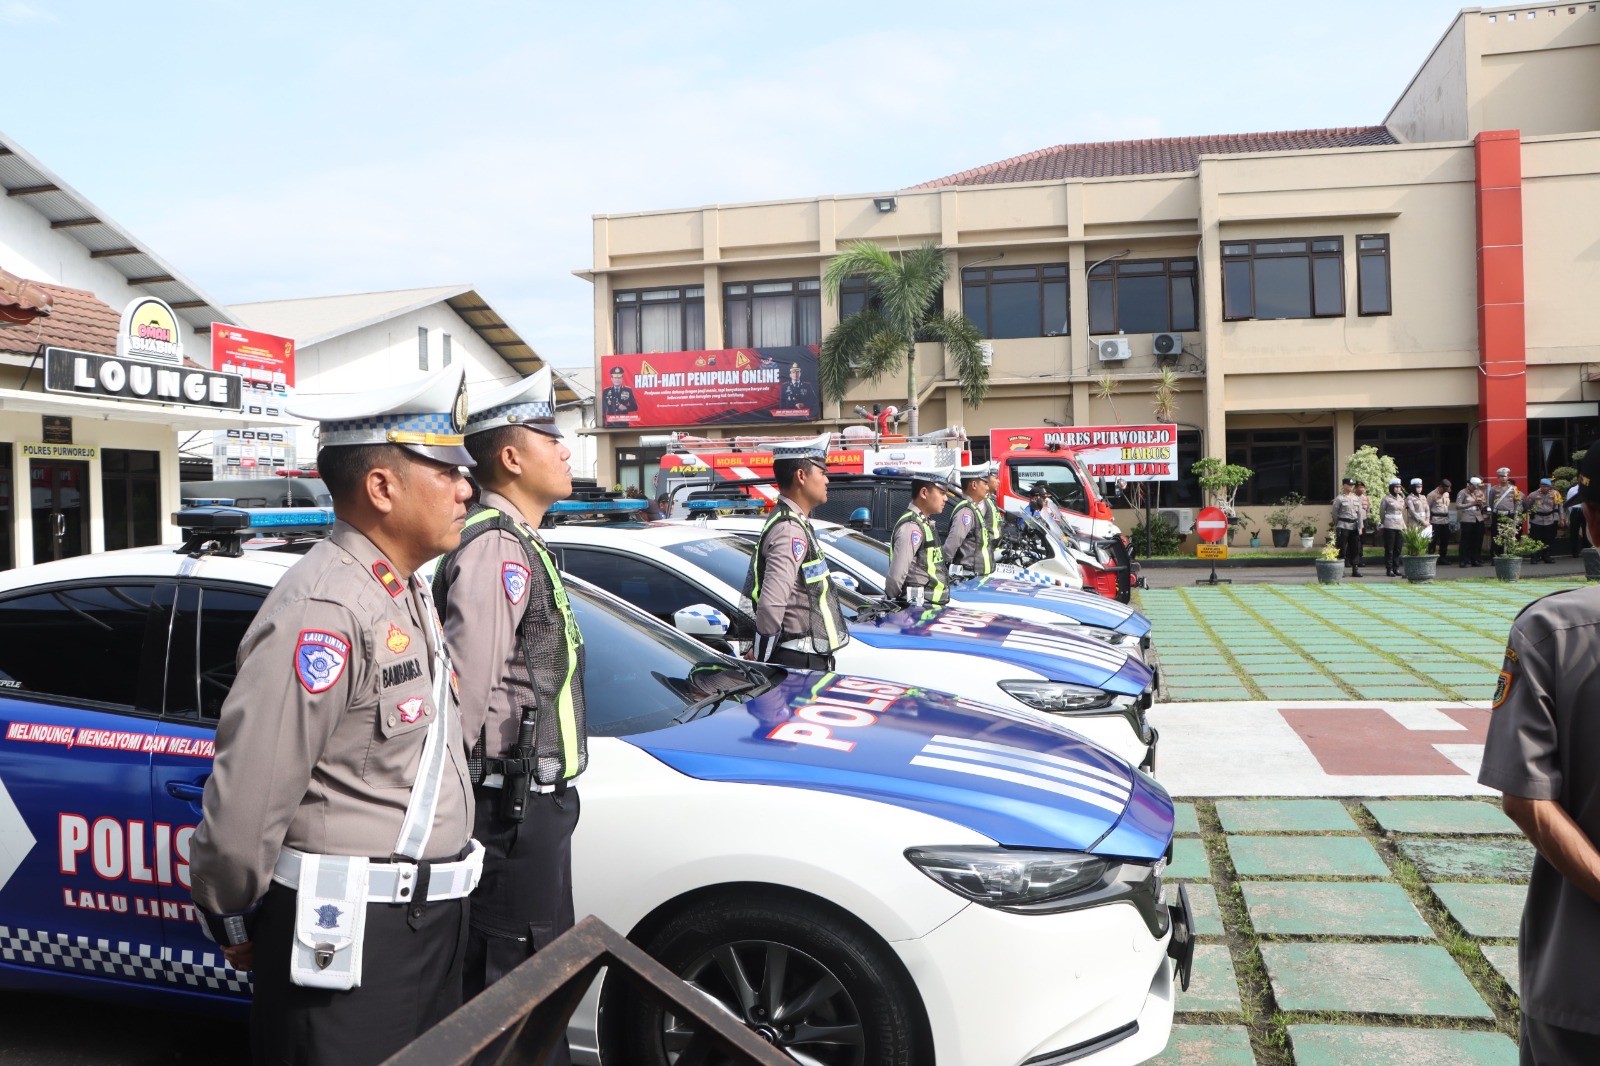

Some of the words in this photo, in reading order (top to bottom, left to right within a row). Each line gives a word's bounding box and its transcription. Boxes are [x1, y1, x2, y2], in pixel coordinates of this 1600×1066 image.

[138, 323, 170, 342] OMAH
[74, 357, 228, 403] LOUNGE
[634, 372, 685, 389] HATI-HATI
[687, 370, 740, 387] PENIPUAN
[741, 368, 780, 384] ONLINE
[1044, 431, 1091, 447] POLRES
[1093, 430, 1170, 445] PURWOREJO
[23, 445, 51, 455] POLRES
[53, 446, 95, 457] PURWOREJO
[826, 454, 860, 463] KARAN
[1121, 447, 1171, 460] HARUS
[1088, 463, 1131, 477] LEBIH
[1134, 462, 1171, 475] BAIK
[303, 632, 323, 642] LALU
[324, 635, 348, 653] LINTAS
[765, 676, 913, 753] POLISI
[8, 723, 75, 747] MELINDUNGI,
[77, 729, 143, 750] MENGAYOMI
[143, 735, 166, 752] DAN
[58, 812, 194, 890] POLIS
[63, 887, 128, 913] LALU
[135, 897, 199, 923] LINT
